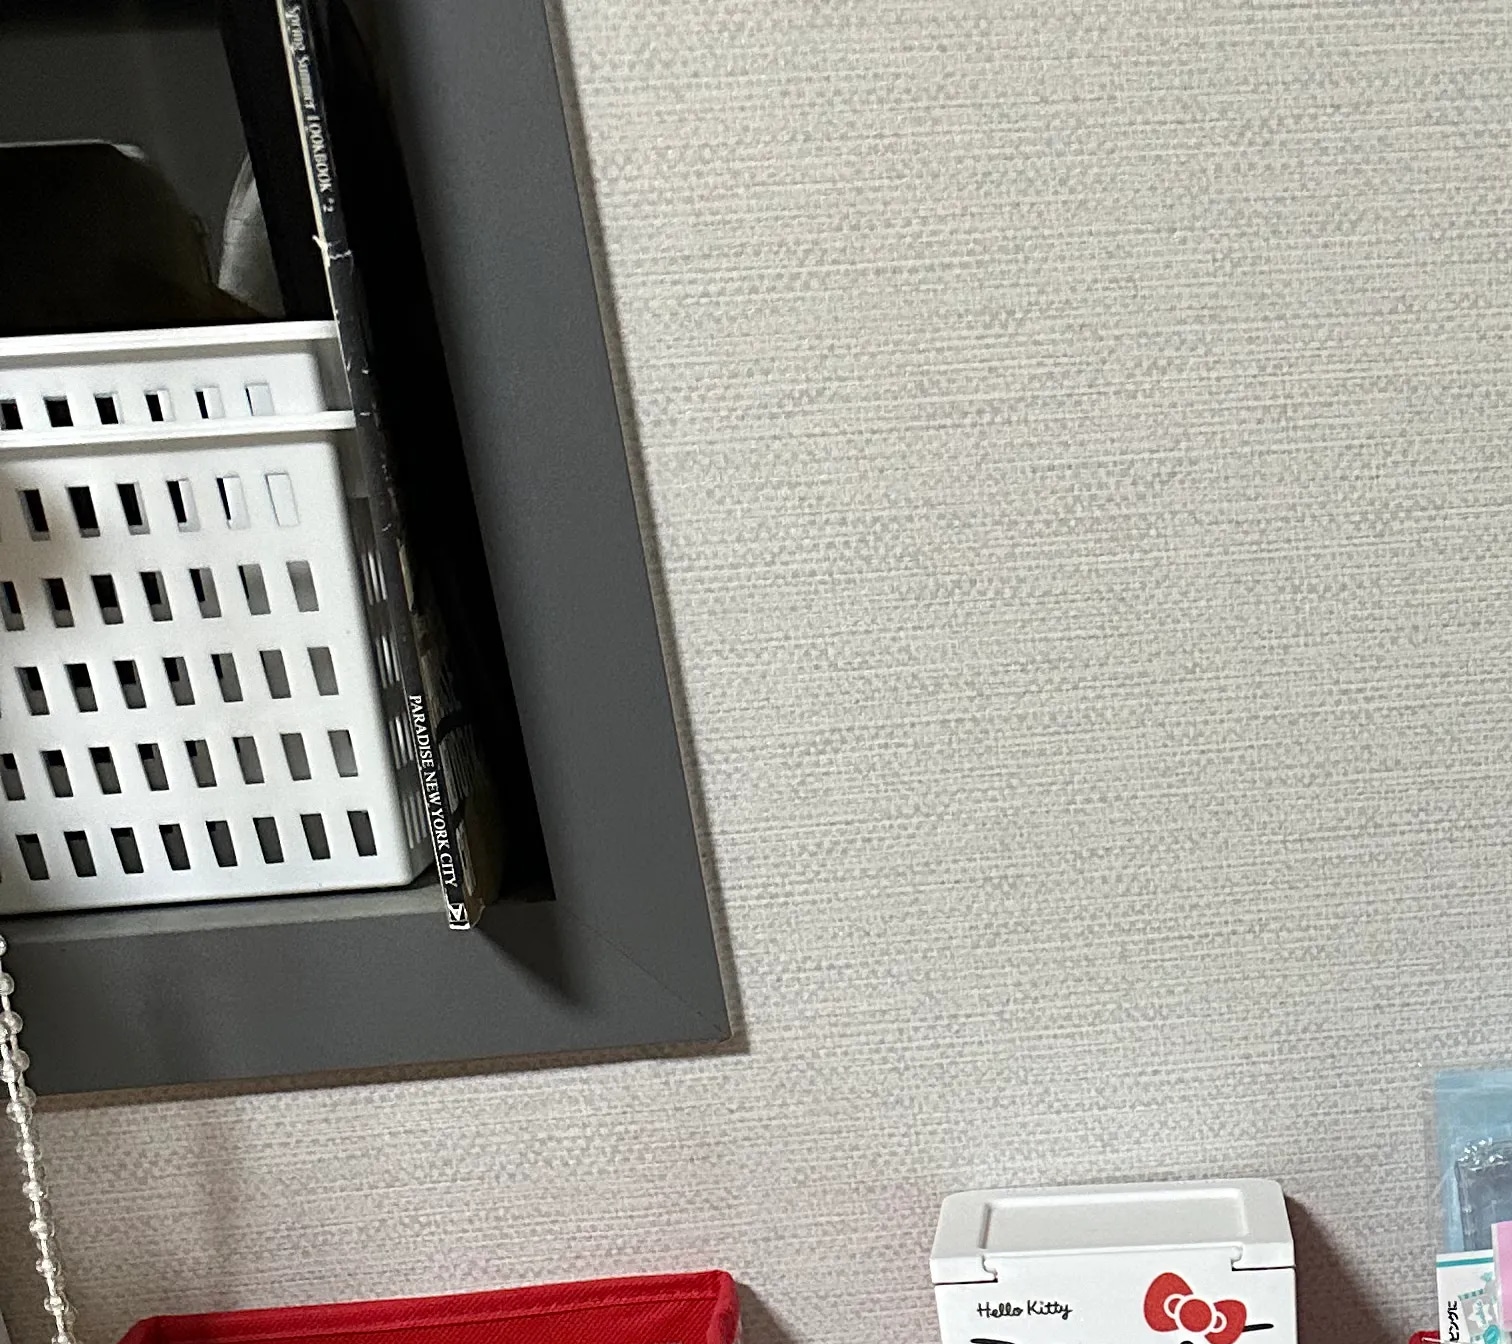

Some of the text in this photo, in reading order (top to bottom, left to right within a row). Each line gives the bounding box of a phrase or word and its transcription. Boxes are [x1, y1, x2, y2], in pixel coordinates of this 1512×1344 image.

[409, 694, 458, 888] PARADISE NEW YORK CITY
[976, 1299, 1074, 1320] Hello Kitty
